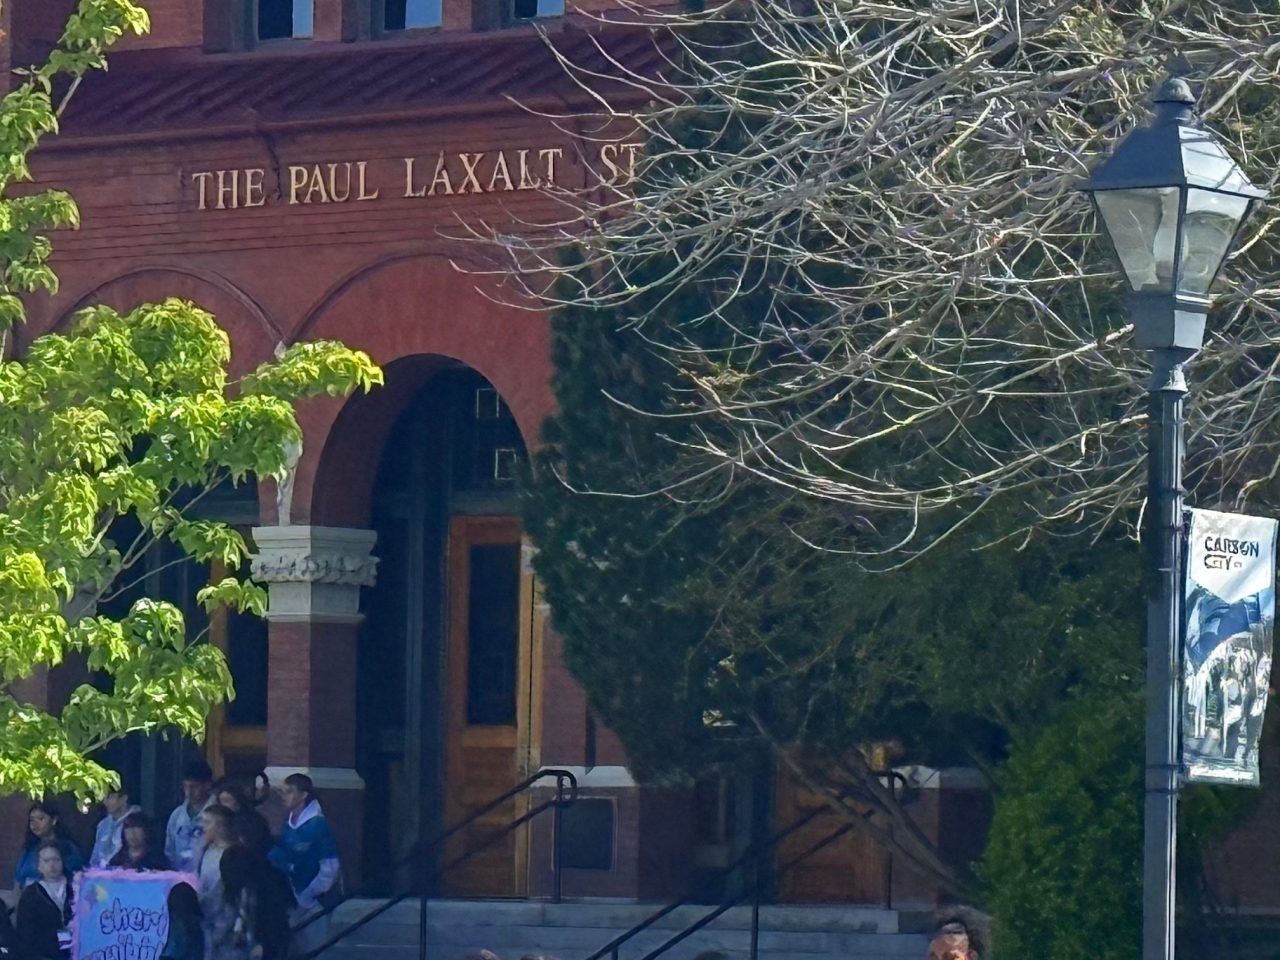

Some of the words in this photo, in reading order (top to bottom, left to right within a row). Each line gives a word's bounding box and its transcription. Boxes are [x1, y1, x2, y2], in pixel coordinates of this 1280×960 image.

[191, 168, 266, 210] THE
[288, 161, 379, 205] PAUL
[403, 148, 563, 198] LAXALT
